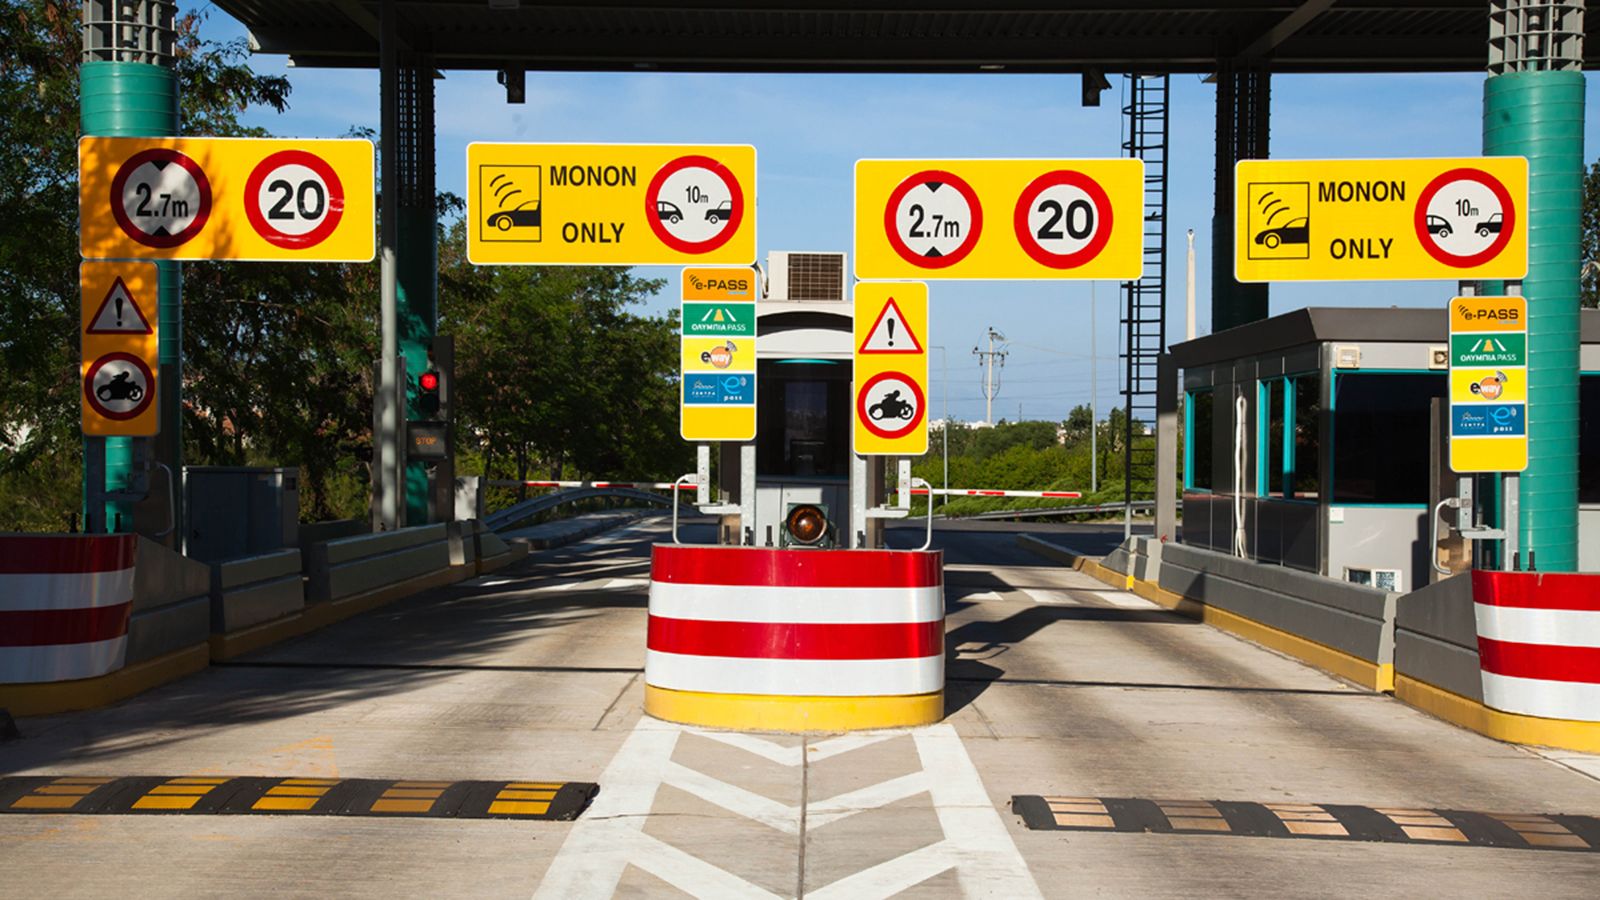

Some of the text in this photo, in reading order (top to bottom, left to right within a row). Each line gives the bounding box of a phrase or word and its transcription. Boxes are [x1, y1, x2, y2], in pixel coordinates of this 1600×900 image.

[549, 165, 637, 187] MONON
[135, 182, 189, 218] 2.7m
[267, 179, 325, 220] 20
[685, 185, 709, 204] 10m
[1318, 180, 1406, 202] MONON
[1455, 199, 1480, 217] 10m
[908, 203, 960, 238] 2.7m
[1037, 199, 1095, 240] 20
[561, 222, 625, 244] ONLY
[1329, 238, 1394, 260] ONLY
